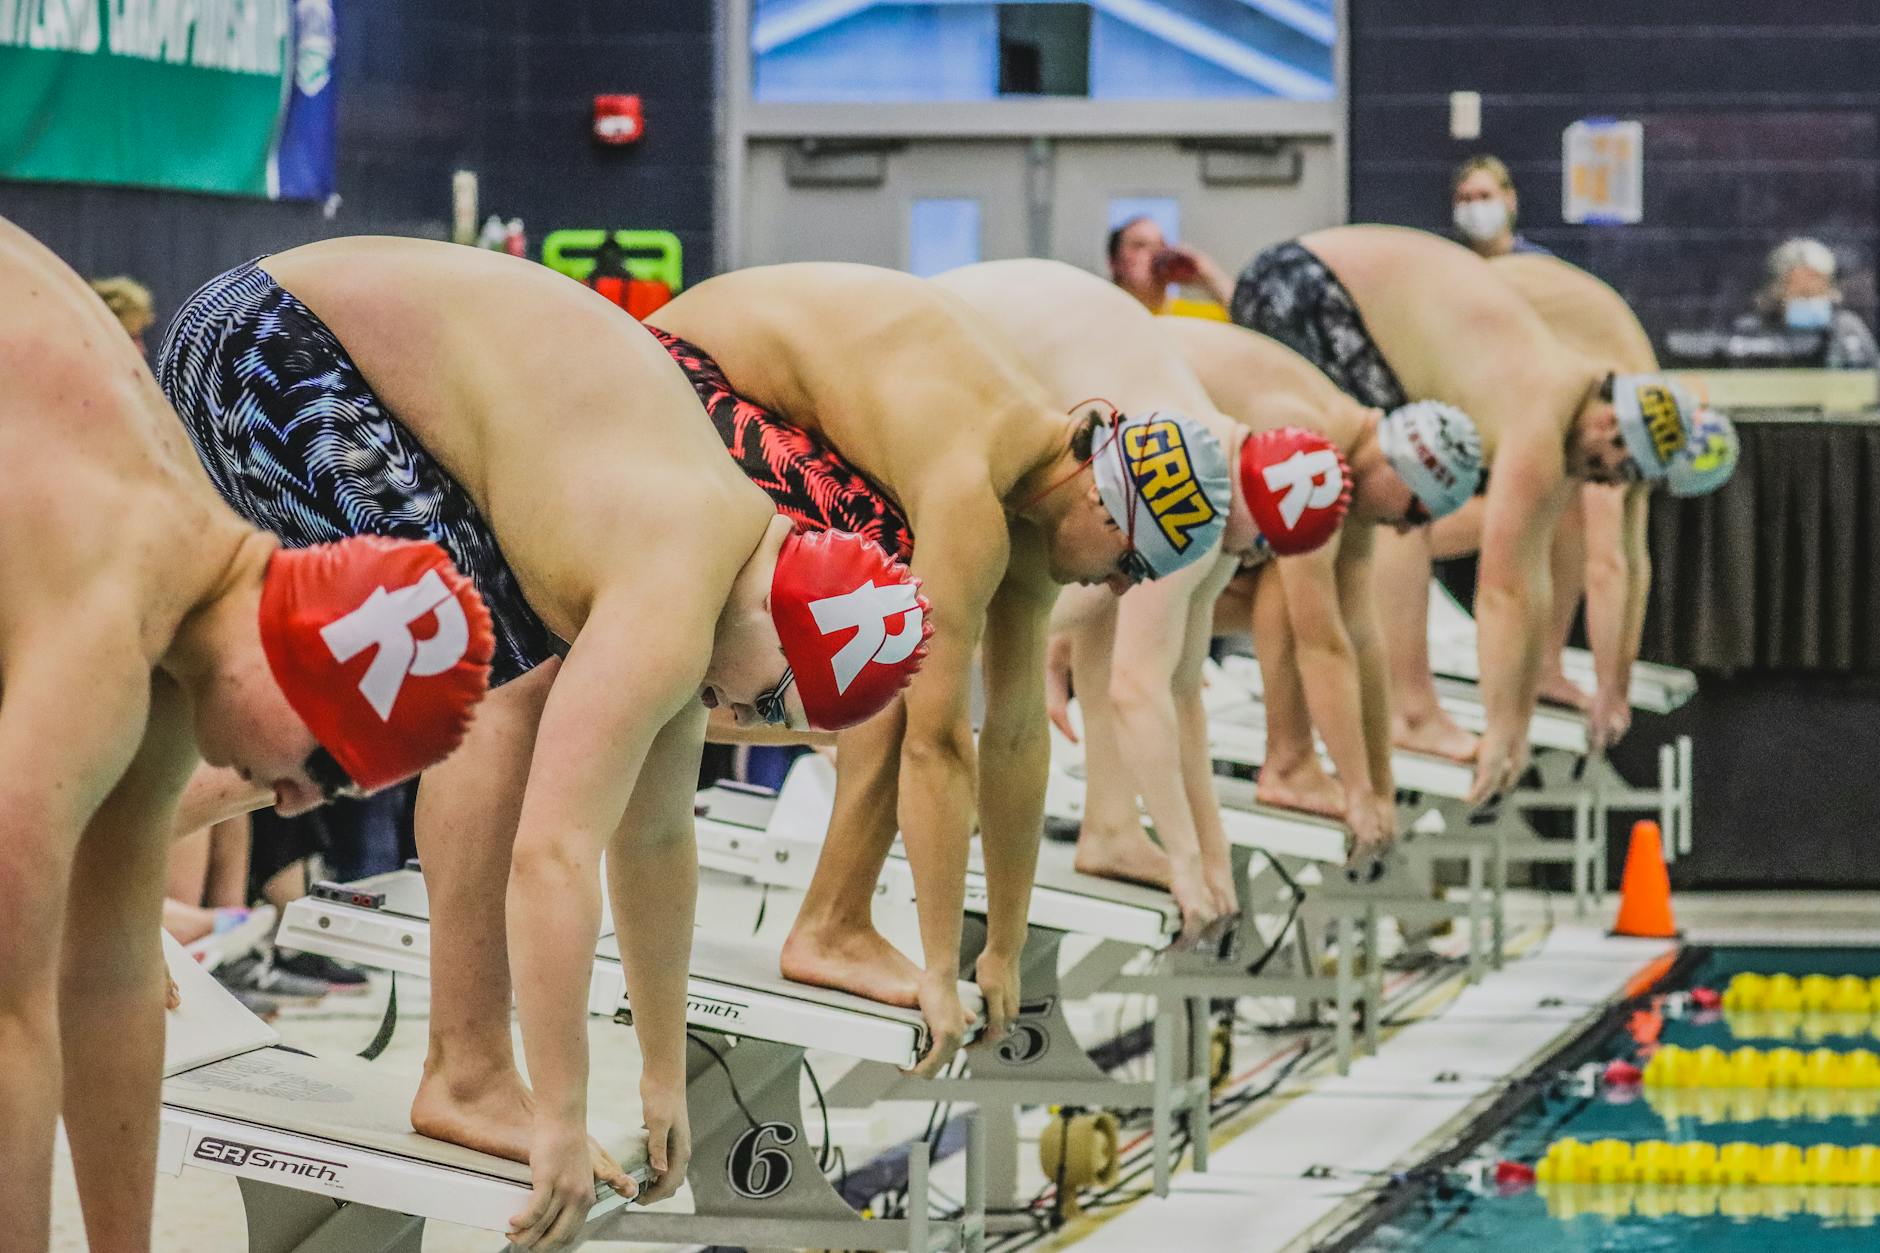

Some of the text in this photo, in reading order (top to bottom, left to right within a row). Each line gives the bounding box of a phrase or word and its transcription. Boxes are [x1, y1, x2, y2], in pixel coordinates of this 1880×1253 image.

[1122, 420, 1219, 555] GRIZ
[1263, 449, 1343, 530] R
[319, 568, 469, 722] R
[808, 579, 923, 696] R
[687, 1001, 739, 1018] mith
[996, 995, 1056, 1067] 5
[727, 1121, 797, 1199] 6
